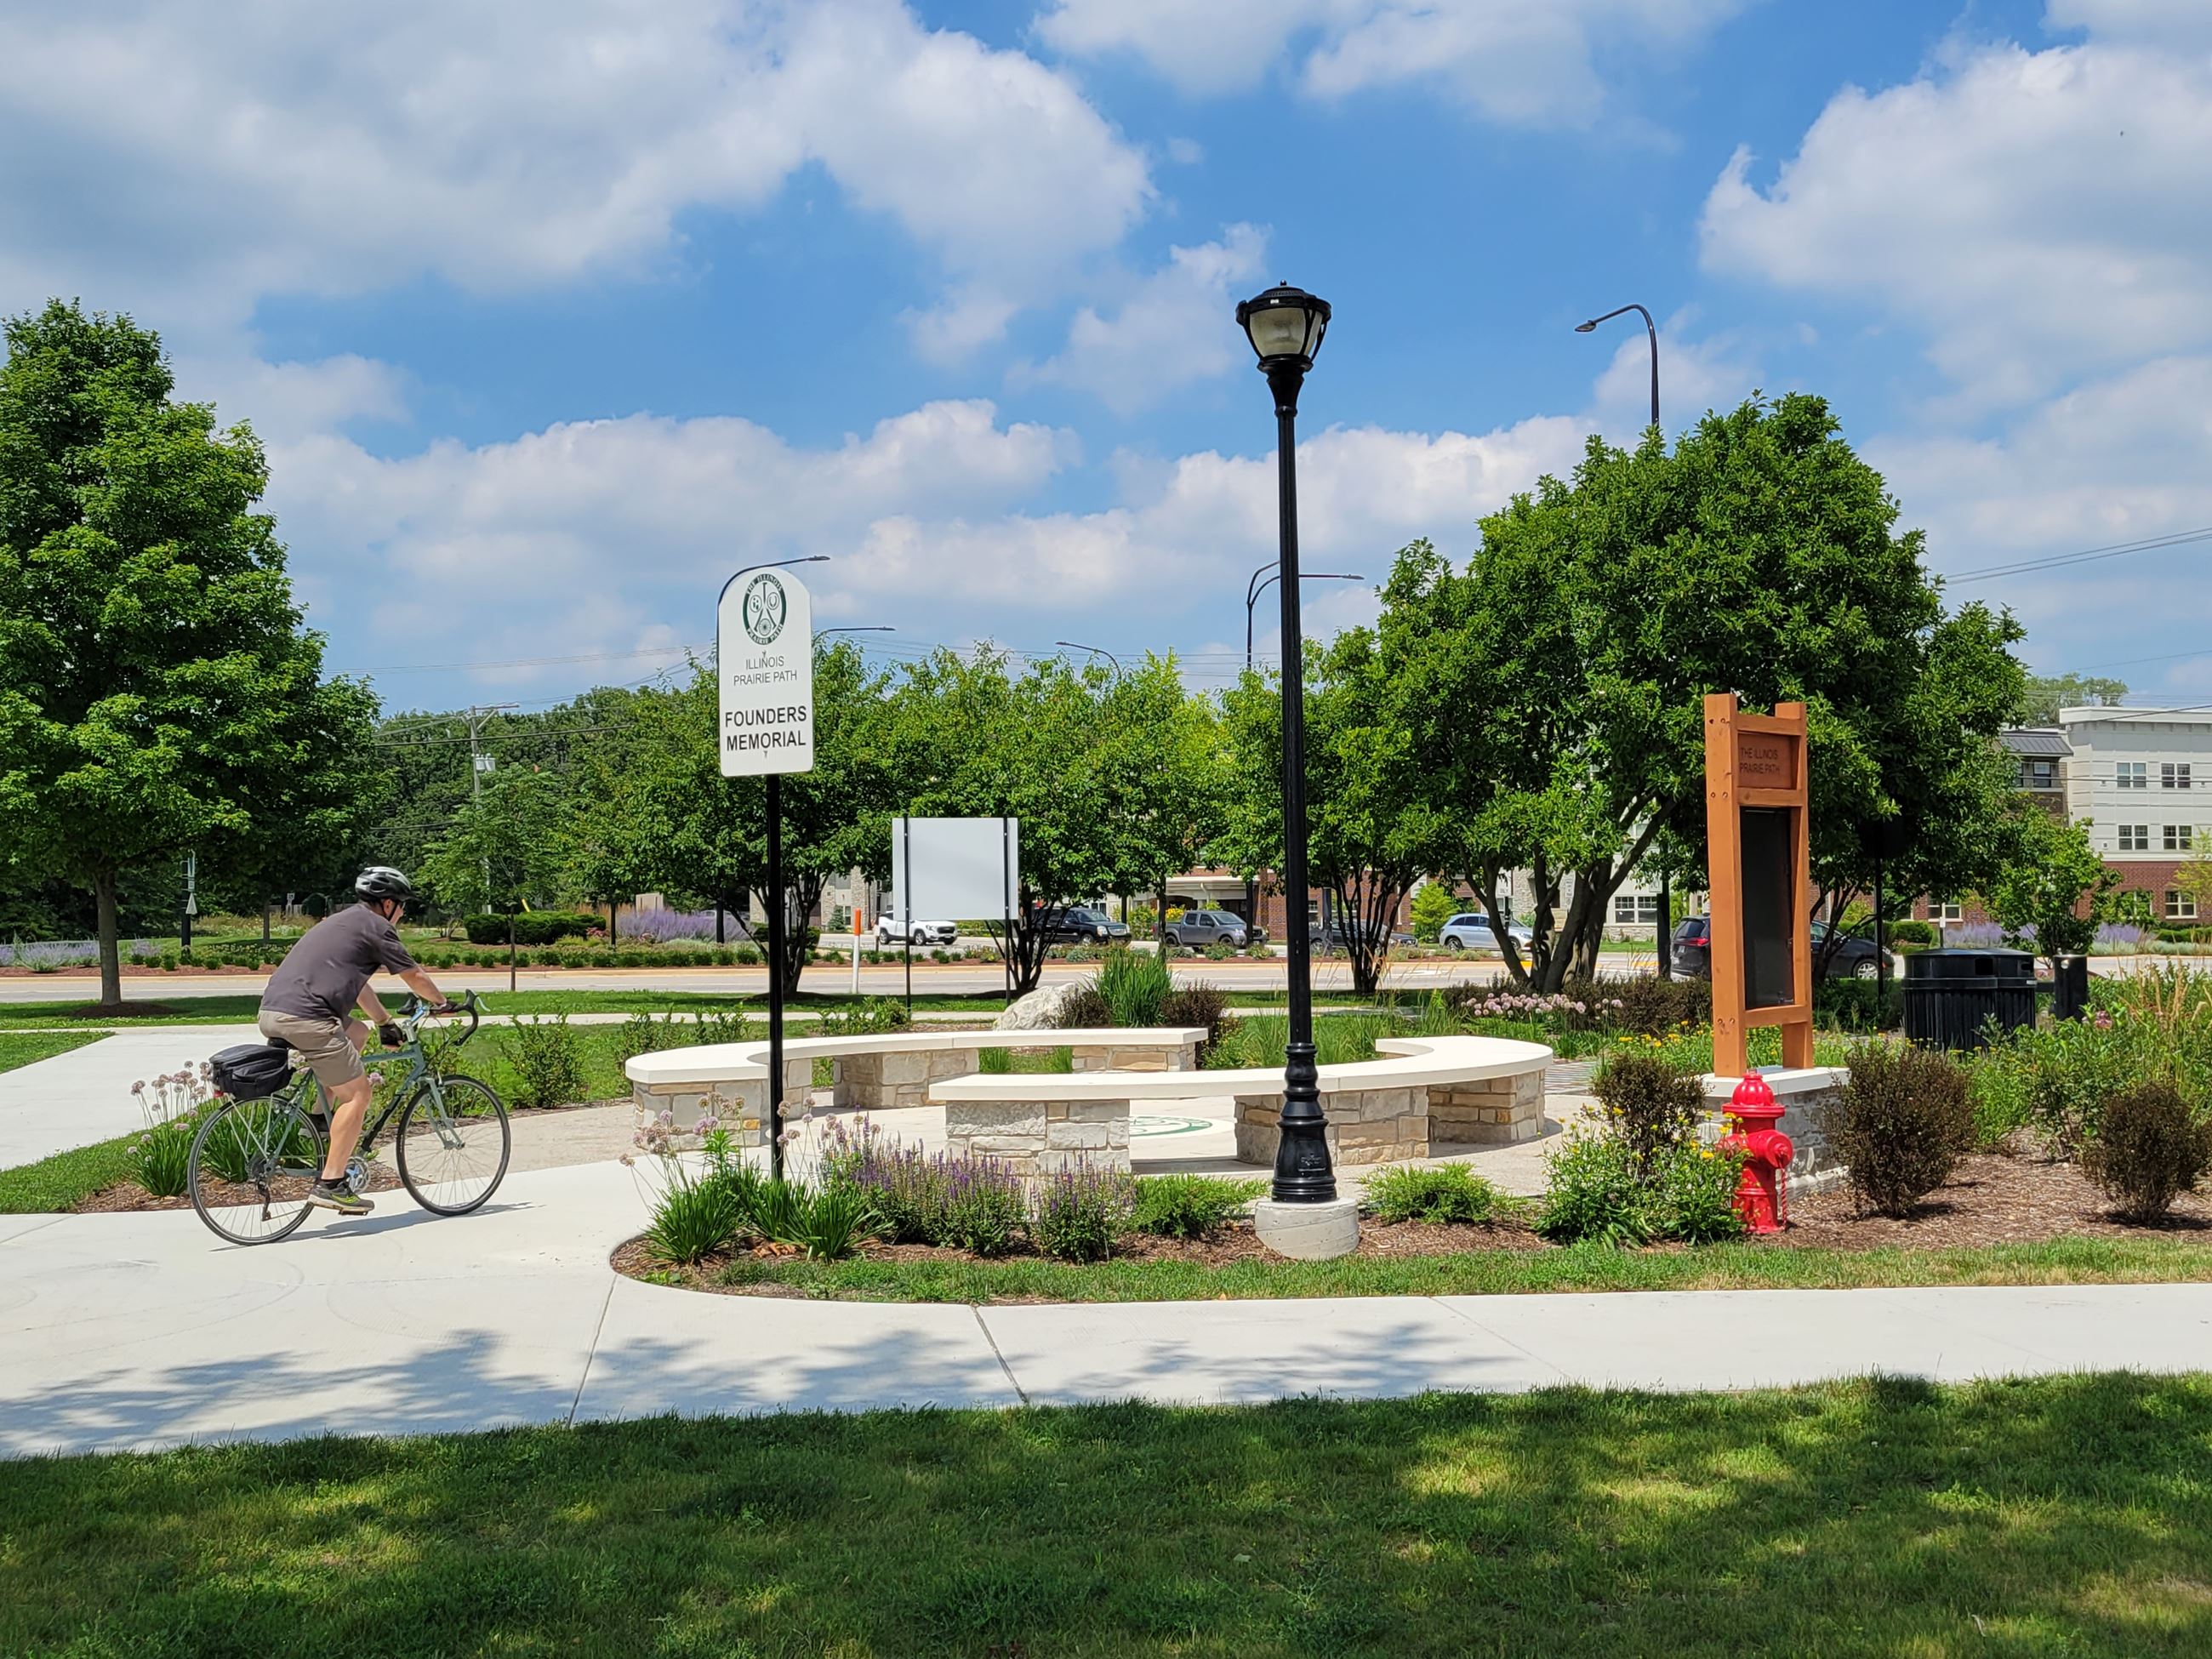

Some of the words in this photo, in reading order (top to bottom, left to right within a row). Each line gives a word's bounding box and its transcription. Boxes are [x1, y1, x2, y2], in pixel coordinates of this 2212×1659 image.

[745, 655, 784, 670] ILLINOIS
[733, 671, 771, 687] PRAIRIE
[773, 670, 797, 683] PATH
[725, 705, 807, 727] FOUNDERS
[727, 730, 807, 751] MEMORIAL
[1741, 747, 1753, 759] THE
[1740, 762, 1764, 774] PRAIRIE
[1764, 763, 1781, 775] PATH
